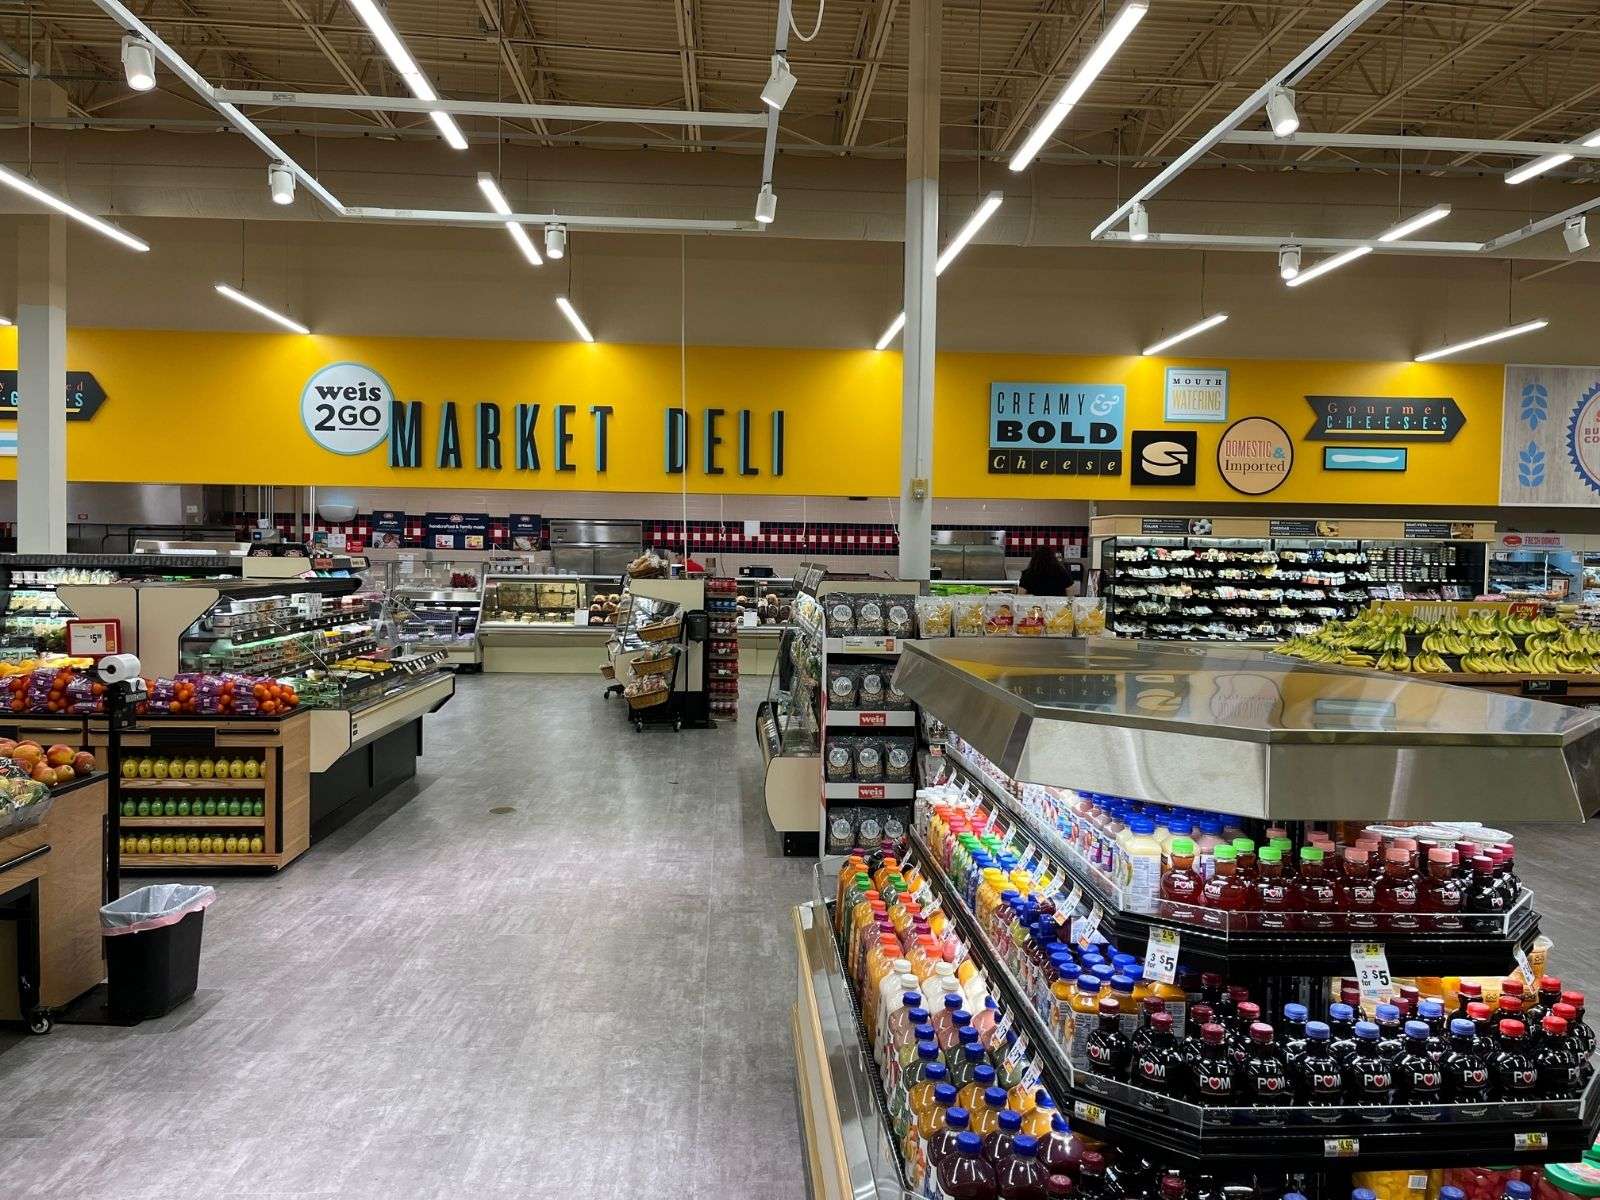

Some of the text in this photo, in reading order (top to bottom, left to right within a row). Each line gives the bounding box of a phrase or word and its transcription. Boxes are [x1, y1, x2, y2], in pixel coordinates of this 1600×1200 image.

[1173, 378, 1222, 386] MOUTH
[314, 381, 382, 401] weis
[997, 391, 1120, 416] CREAMY &
[1172, 389, 1221, 411] WATERING
[1327, 402, 1448, 415] Gourmet
[314, 403, 382, 432] 2GO
[388, 400, 784, 476] MARKET DELI
[996, 420, 1118, 444] BOLD
[1225, 440, 1286, 459] DOMESTIC &
[993, 455, 1116, 472] Cheese
[1225, 459, 1285, 475] Imported
[861, 715, 885, 723] weis
[860, 787, 883, 796] weis
[1174, 880, 1194, 889] POM
[1263, 886, 1284, 898] POM
[1354, 888, 1375, 899] POM
[1491, 897, 1504, 908] PO
[1150, 952, 1175, 971] 3 $5
[1361, 969, 1390, 986] 3 $5
[1086, 1041, 1110, 1061] POM
[1139, 1058, 1166, 1078] POM
[1200, 1074, 1232, 1090] POM
[1257, 1076, 1286, 1091] POM
[1314, 1073, 1342, 1088] POM
[1364, 1072, 1392, 1087] POM
[1414, 1071, 1442, 1086] POM
